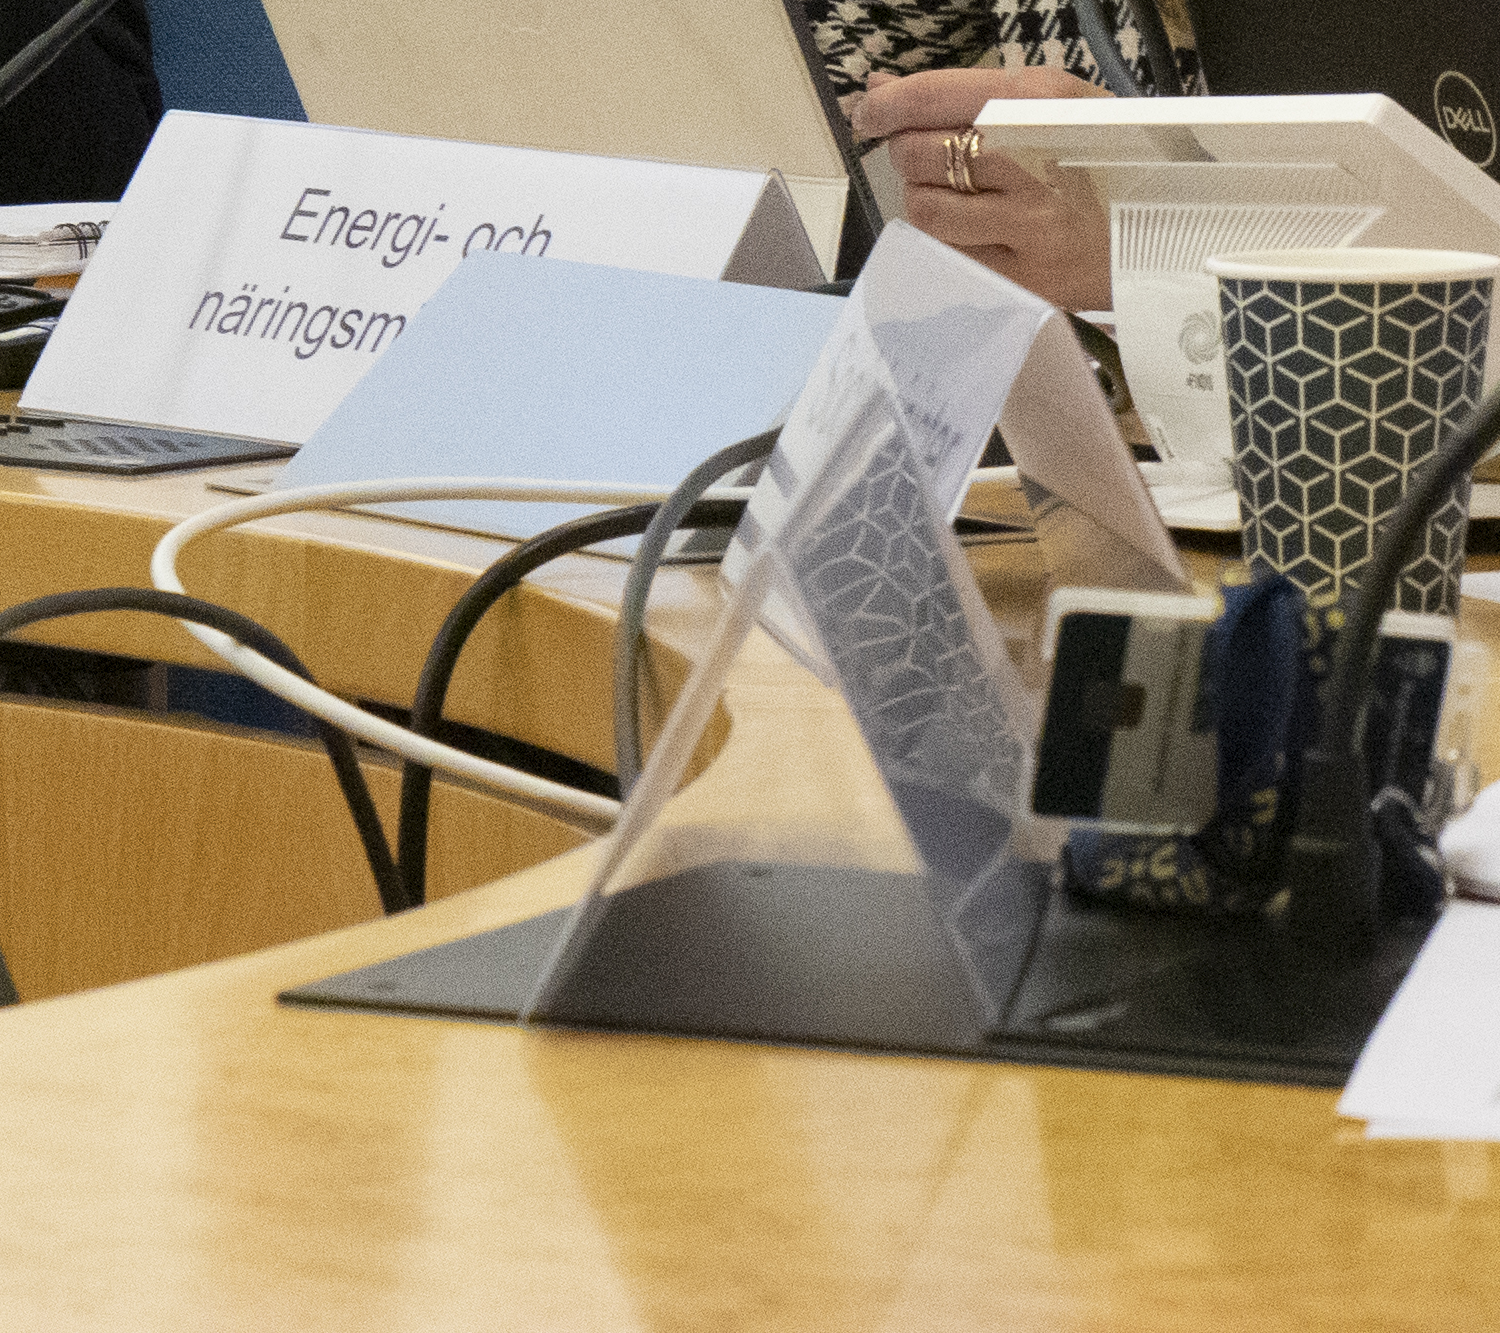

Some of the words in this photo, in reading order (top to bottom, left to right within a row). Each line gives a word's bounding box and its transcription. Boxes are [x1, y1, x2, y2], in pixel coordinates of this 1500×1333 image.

[1442, 105, 1491, 133] DELL
[279, 187, 449, 269] Energi-
[188, 282, 407, 360] näringsm
